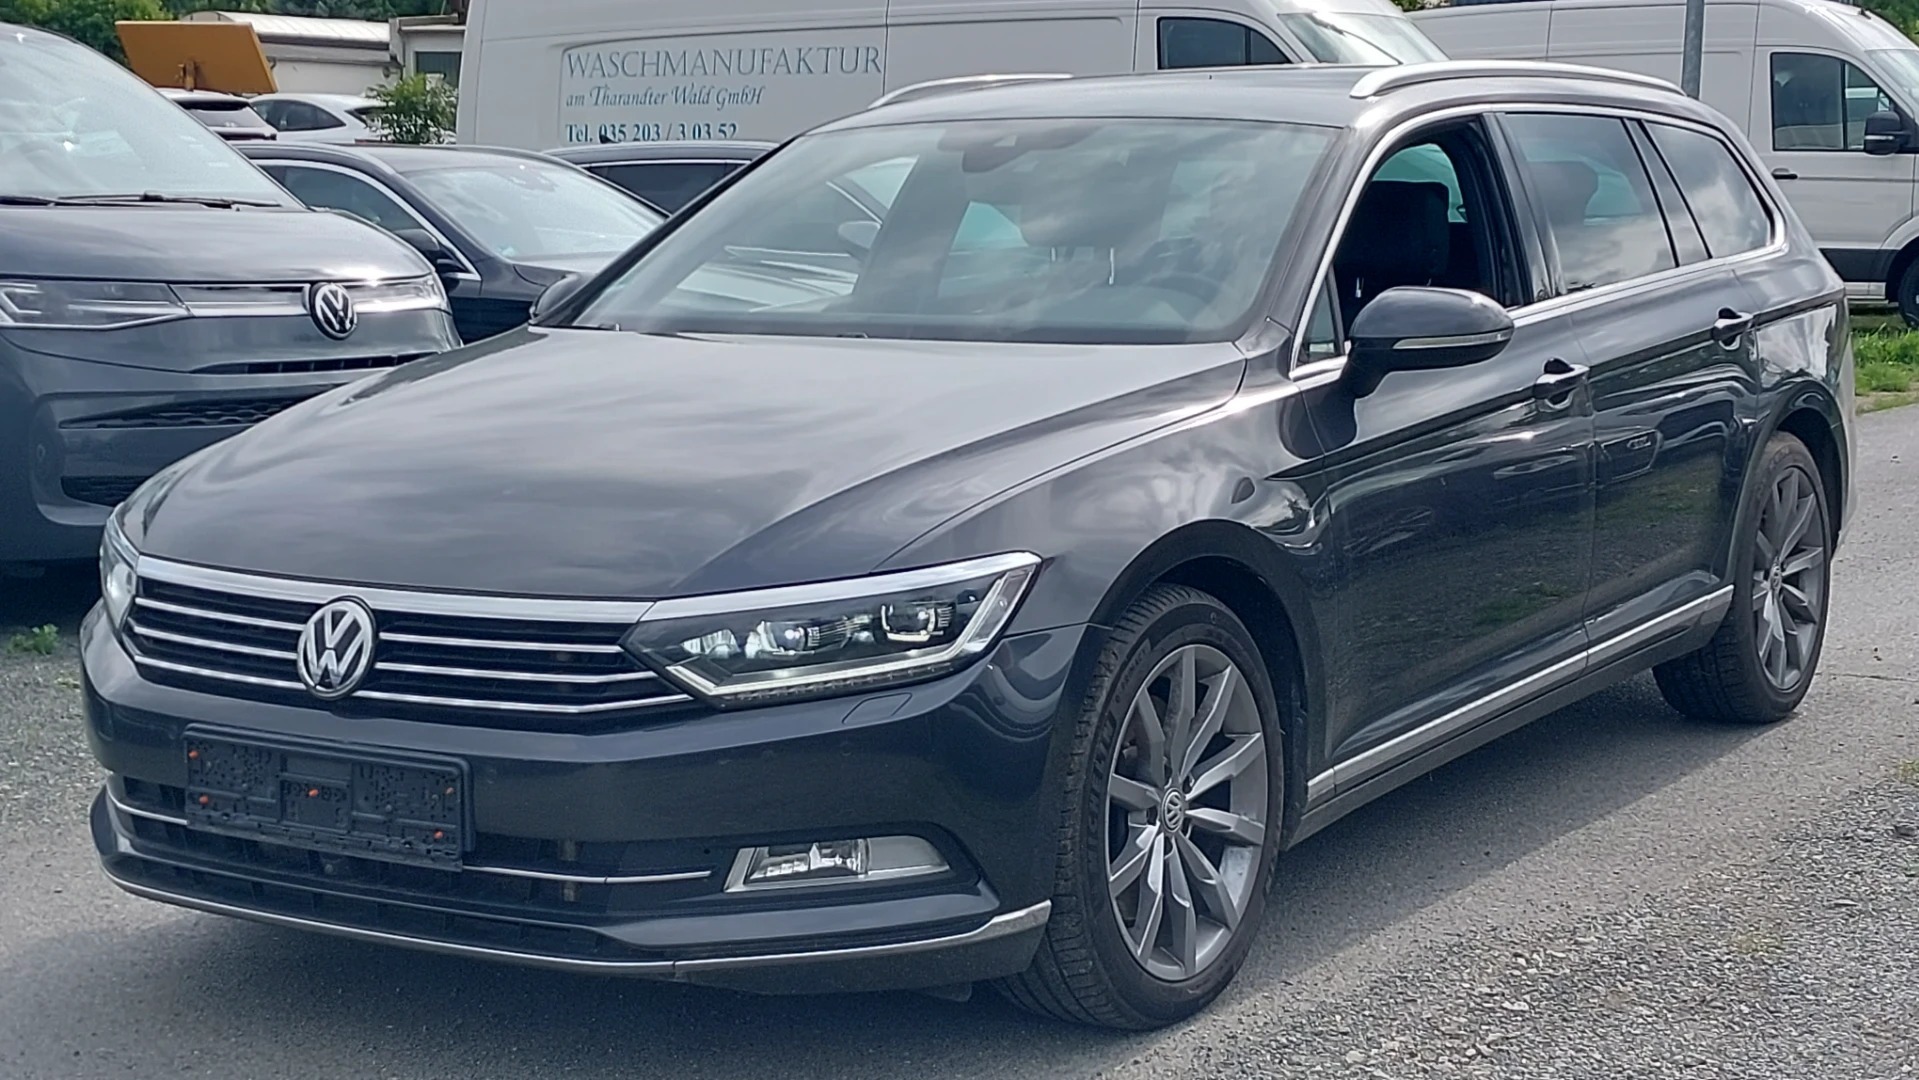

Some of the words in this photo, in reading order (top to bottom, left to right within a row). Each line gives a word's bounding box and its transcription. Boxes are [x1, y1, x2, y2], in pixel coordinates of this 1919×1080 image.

[566, 46, 883, 79] WASCHMANUFAKTUR
[566, 94, 586, 107] am
[590, 84, 669, 107] Tharandter
[671, 82, 714, 106] Wald
[715, 86, 763, 111] GmbH
[566, 123, 593, 143] Tel.
[598, 123, 627, 143] 035
[632, 123, 660, 142] 203
[692, 123, 712, 141] 03
[299, 601, 372, 693] VW
